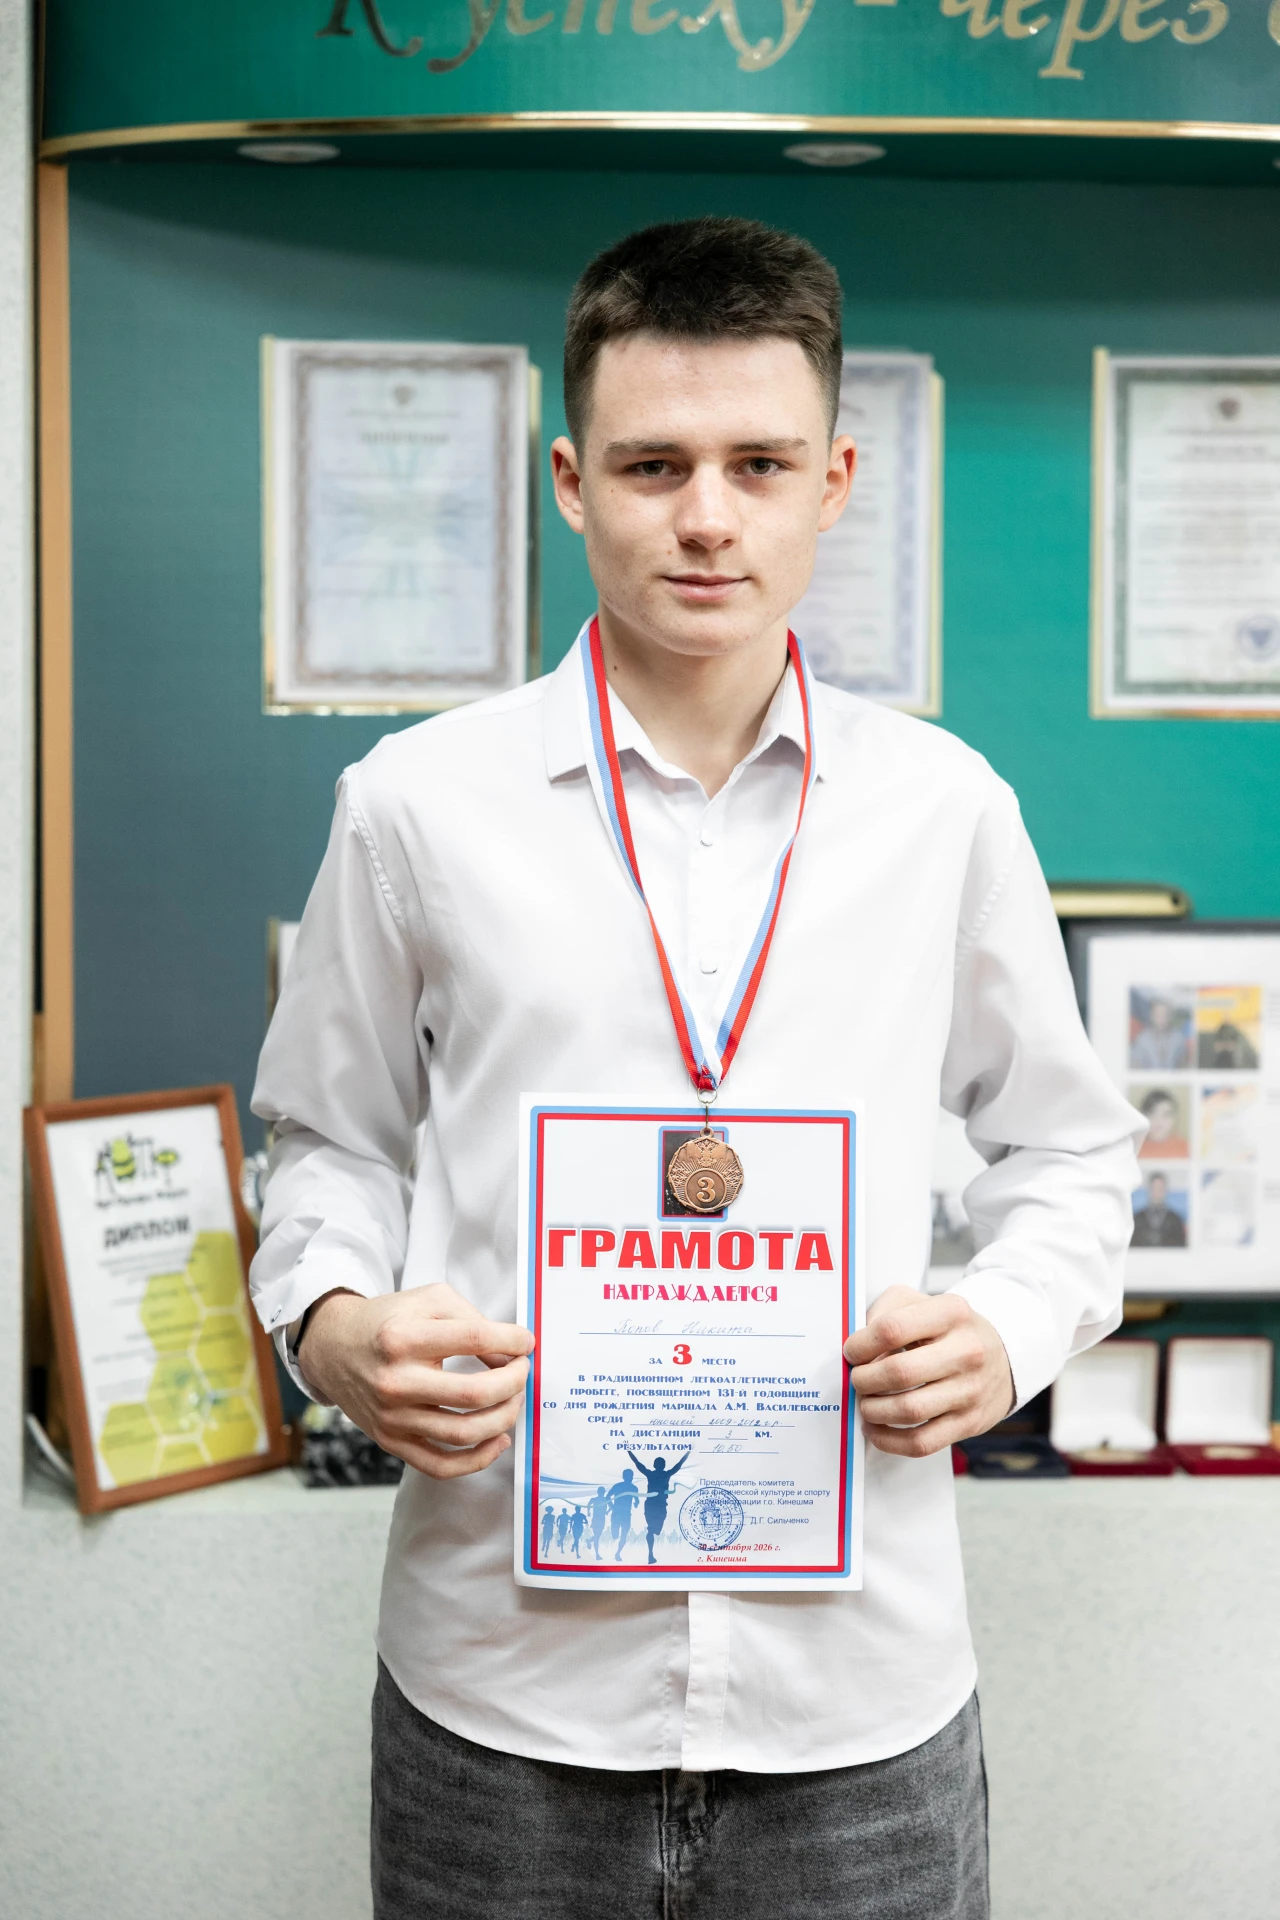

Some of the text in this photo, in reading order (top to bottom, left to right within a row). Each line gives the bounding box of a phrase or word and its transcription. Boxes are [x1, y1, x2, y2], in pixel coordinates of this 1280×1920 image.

[696, 1177, 716, 1202] 3
[547, 1228, 835, 1271] ГРАМОТА
[603, 1284, 778, 1303] НАГРАЖДАЕТСЯ
[648, 1344, 737, 1366] ЗА 3 МЕСТО
[592, 1375, 683, 1384] ТРАДИЦИОННОМ
[690, 1376, 806, 1385] ЛЕГКОАТЛЕТИЧЕСКОМ
[570, 1388, 620, 1397] ПРОБЕГЕ,
[626, 1389, 711, 1398] ПОСВЯЩЕННОМ
[753, 1390, 821, 1399] ГОДОВЩИНЕ
[542, 1401, 557, 1409] СО
[563, 1401, 587, 1410] ДНЯ
[593, 1402, 655, 1411] РОЖДЕНИЯ
[661, 1402, 717, 1411] МАРШАЛА
[724, 1402, 749, 1411] А.М.
[587, 1415, 623, 1424] СРЕДИ
[609, 1429, 625, 1437] НА
[632, 1429, 701, 1438] ДИСТАНЦИИ
[725, 1430, 733, 1439] 3
[602, 1443, 610, 1451] С
[616, 1443, 693, 1451] РЕЗУЛЬТАТОМ
[699, 1479, 757, 1488] Председатель
[804, 1490, 830, 1498] спорту
[777, 1498, 814, 1506] Кинешма
[767, 1516, 810, 1525] Сильченко
[753, 1543, 773, 1551] 2026
[706, 1554, 747, 1563] Кинешма
